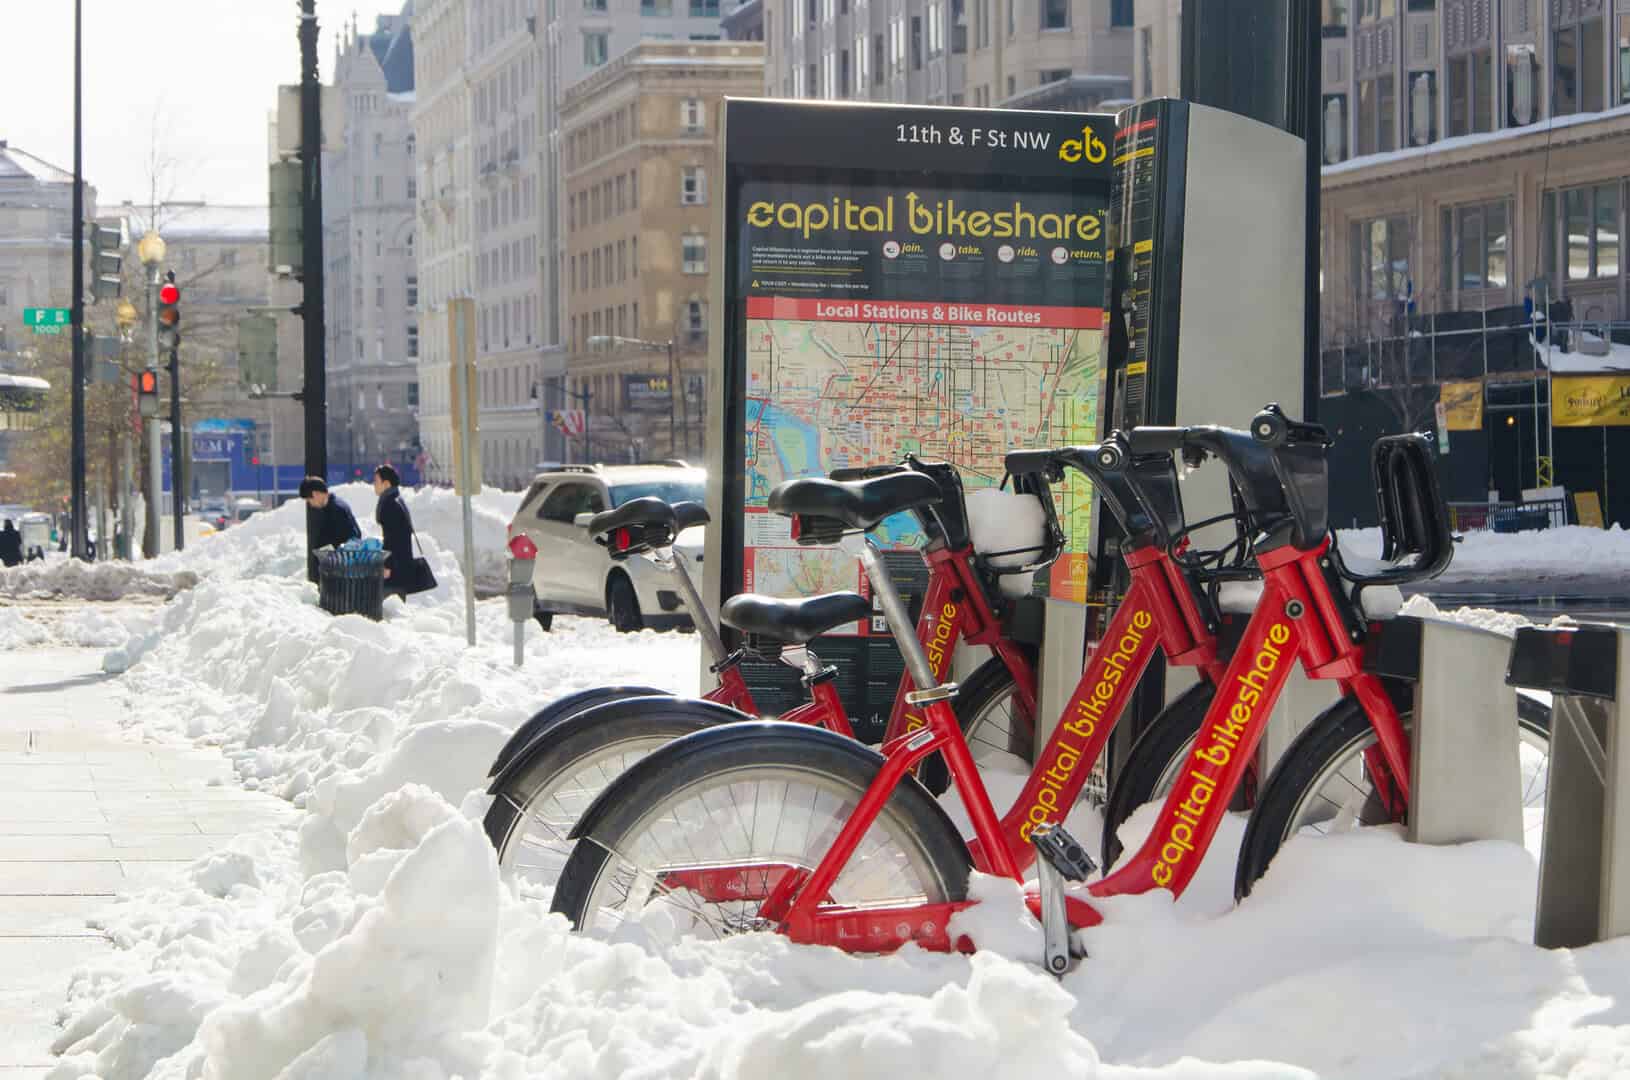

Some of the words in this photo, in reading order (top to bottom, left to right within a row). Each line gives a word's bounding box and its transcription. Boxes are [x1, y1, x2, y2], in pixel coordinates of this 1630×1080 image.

[896, 124, 941, 144] 11th
[949, 126, 964, 145] &
[971, 128, 982, 146] F
[987, 129, 1007, 148] St
[1013, 131, 1050, 150] NW
[747, 196, 893, 239] capital
[905, 191, 1101, 240] bikeshare
[1016, 247, 1038, 257] ride.
[1070, 250, 1103, 259] return.
[36, 310, 46, 323] F
[816, 302, 858, 318] Local
[863, 304, 929, 321] Stations
[932, 306, 944, 321] &
[948, 307, 982, 322] Bike
[986, 309, 1041, 324] Routes
[929, 603, 956, 677] eshare
[1063, 610, 1152, 737] bikeshare
[1152, 771, 1216, 886] capital
[1195, 623, 1290, 766] bikeshare
